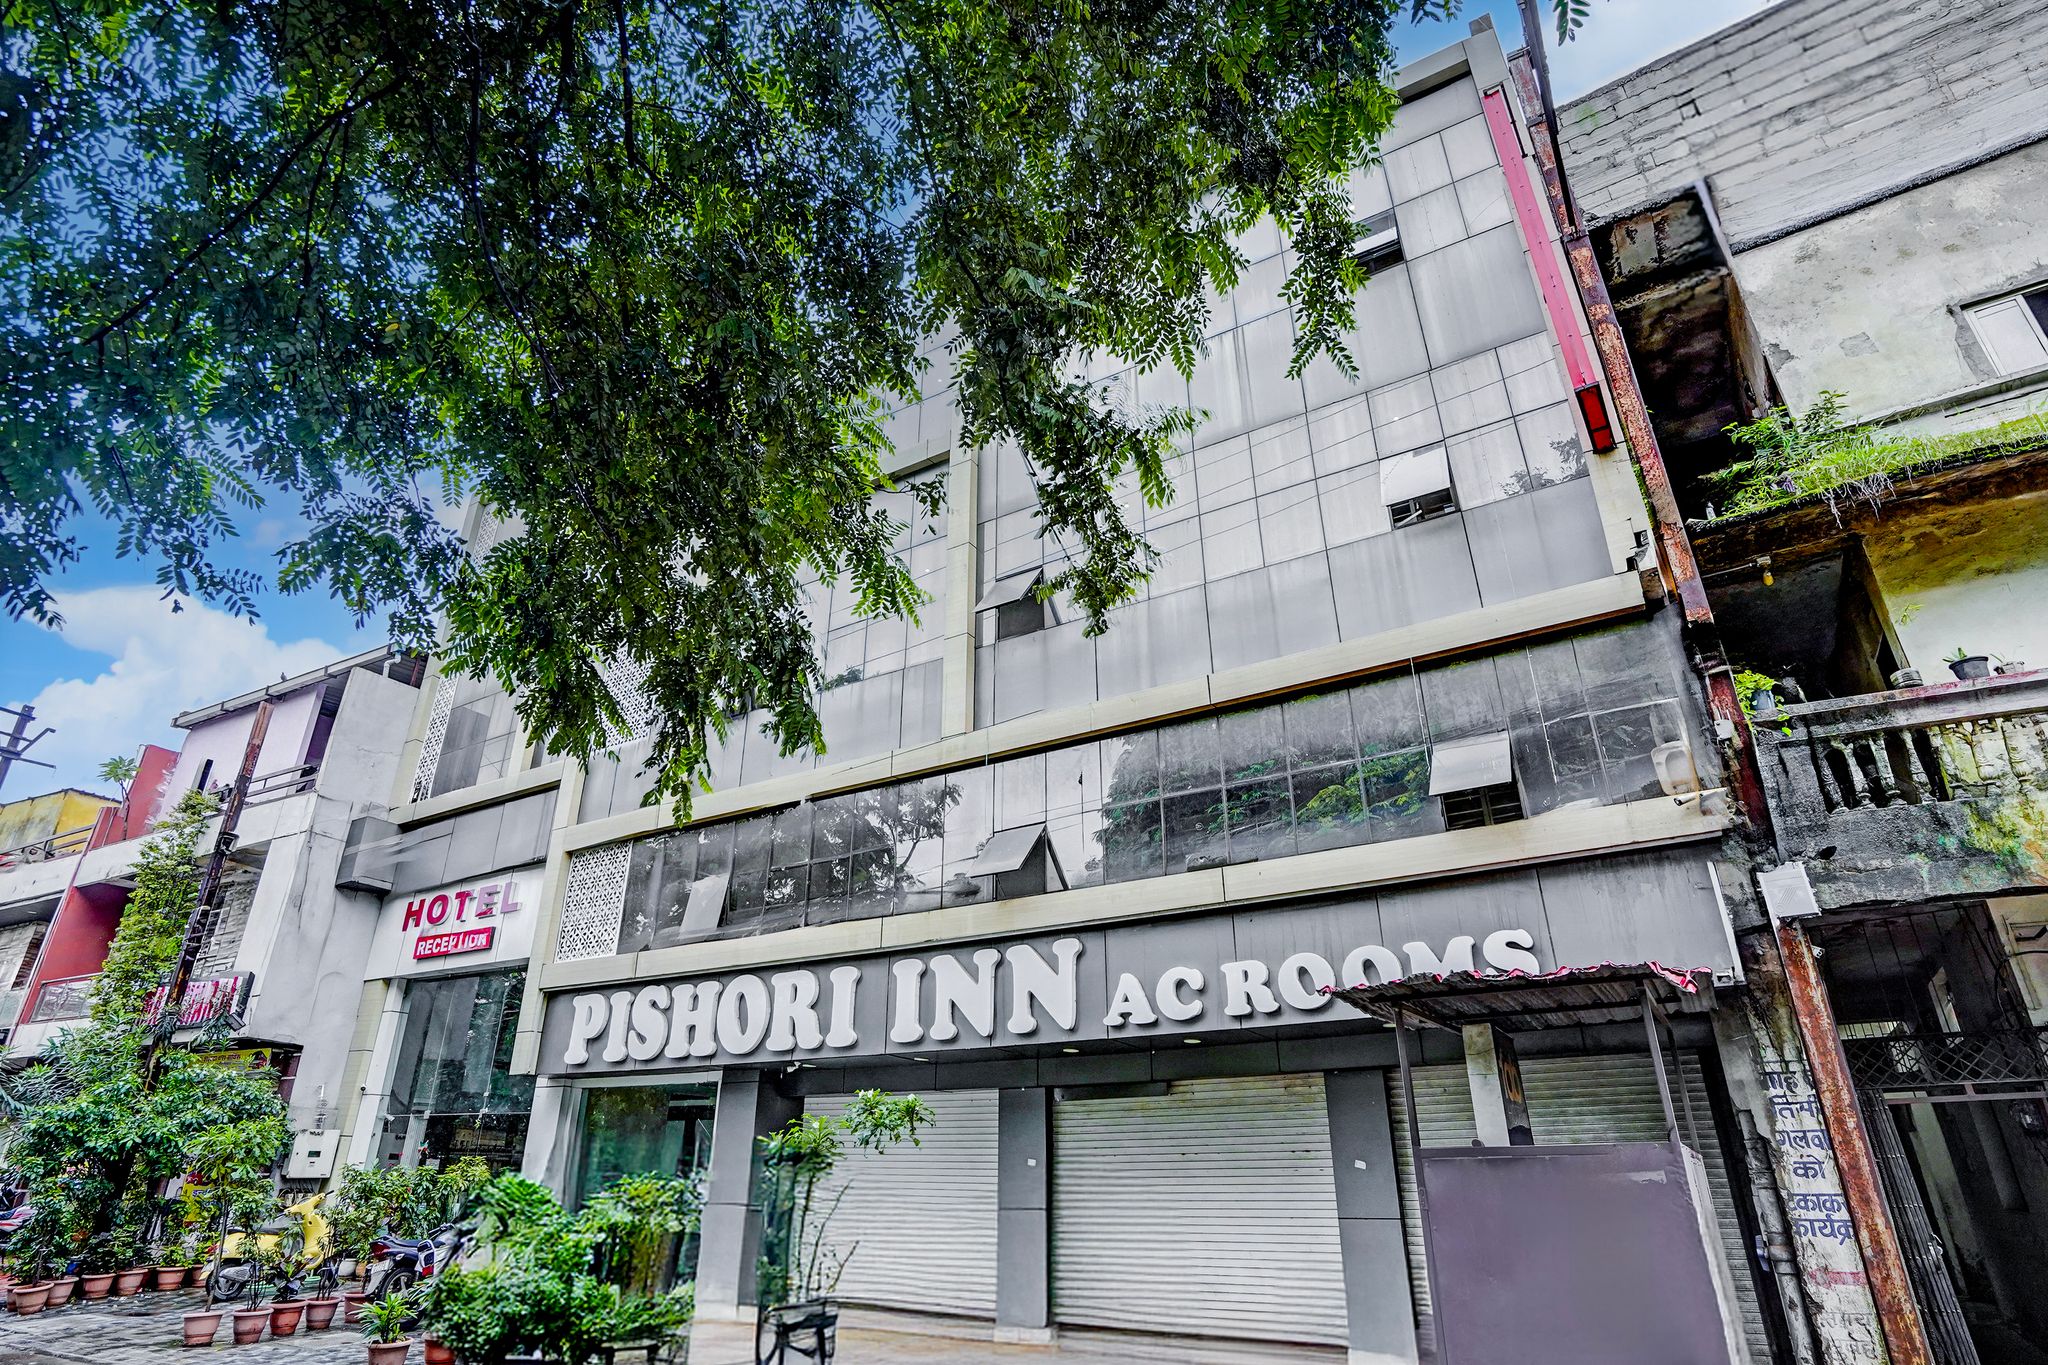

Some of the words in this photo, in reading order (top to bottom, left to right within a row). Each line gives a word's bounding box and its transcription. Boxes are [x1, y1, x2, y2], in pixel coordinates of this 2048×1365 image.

[401, 882, 519, 931] HOTEL
[564, 967, 861, 1065] PISHORI
[890, 938, 1083, 1043] INN
[1103, 966, 1205, 1027] AC
[1221, 929, 1540, 1016] ROOMS
